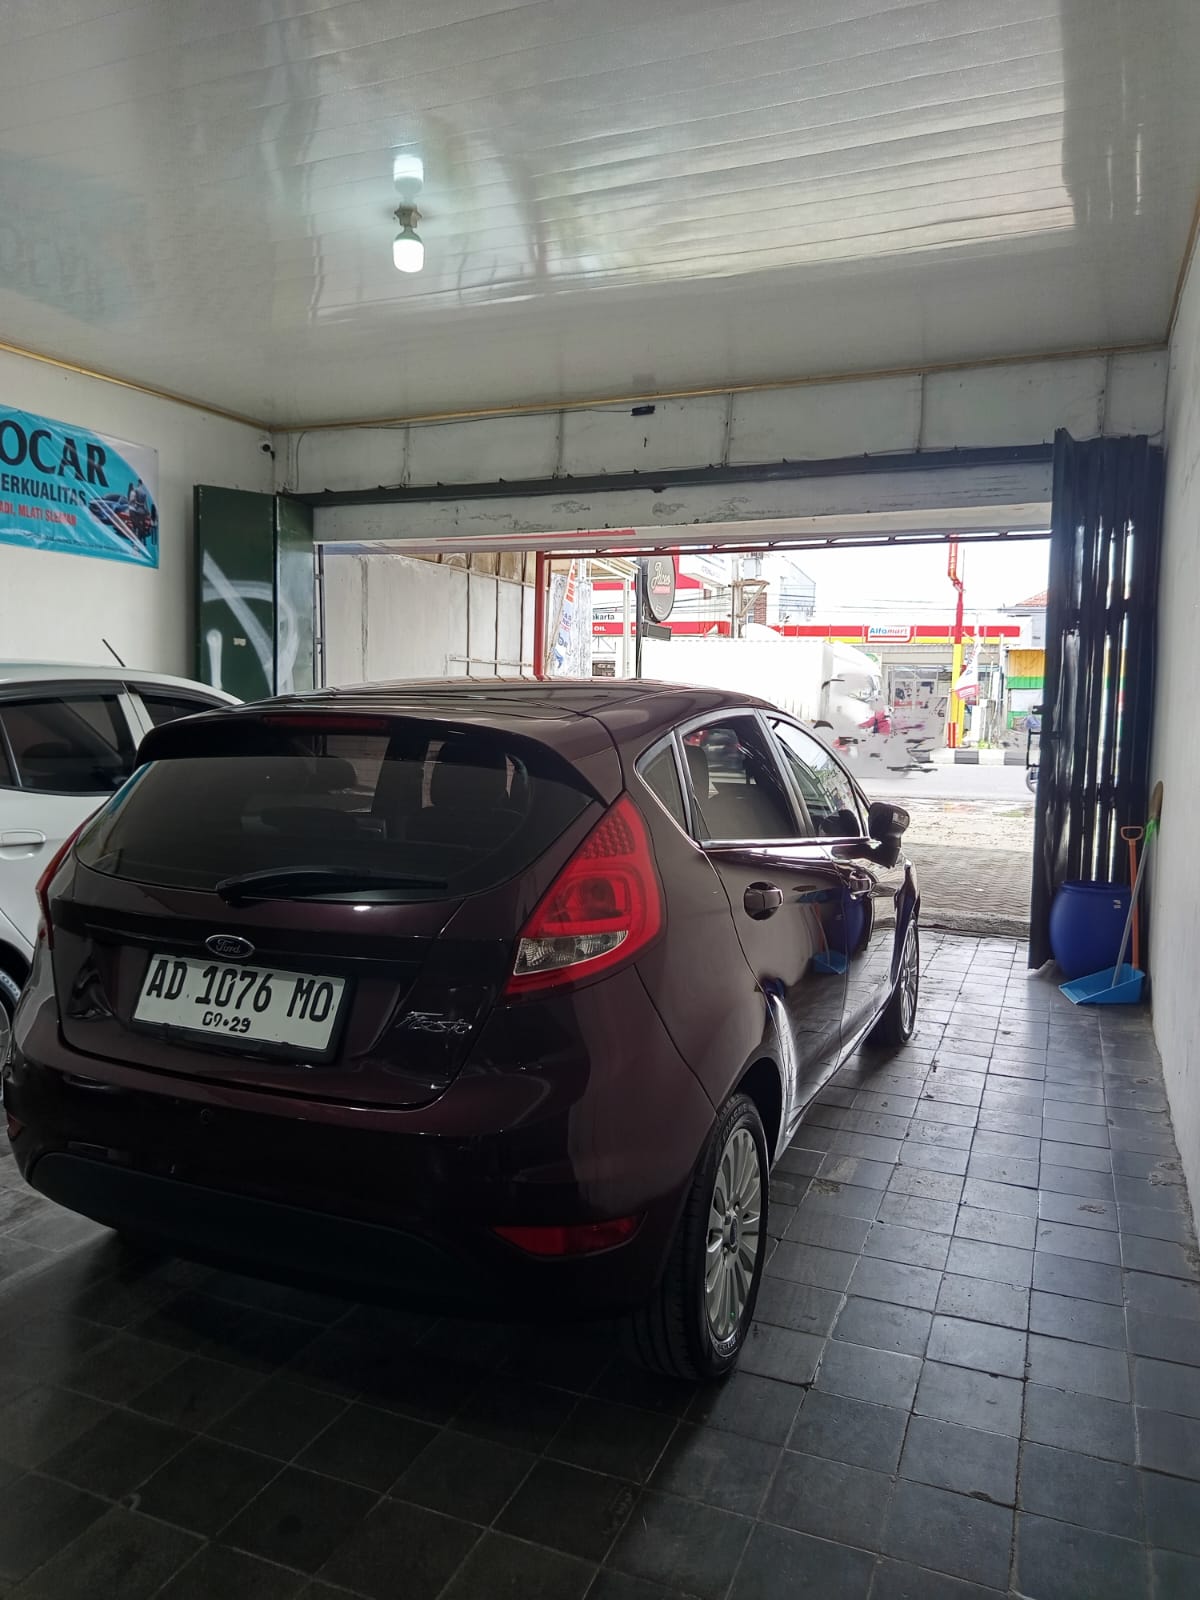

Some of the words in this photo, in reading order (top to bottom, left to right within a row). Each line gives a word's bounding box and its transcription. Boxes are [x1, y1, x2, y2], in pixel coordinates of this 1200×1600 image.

[870, 627, 907, 635] Alfamart
[216, 939, 241, 953] Ford
[146, 959, 187, 1000] AD
[195, 965, 274, 1013] 1076
[286, 977, 334, 1022] MO
